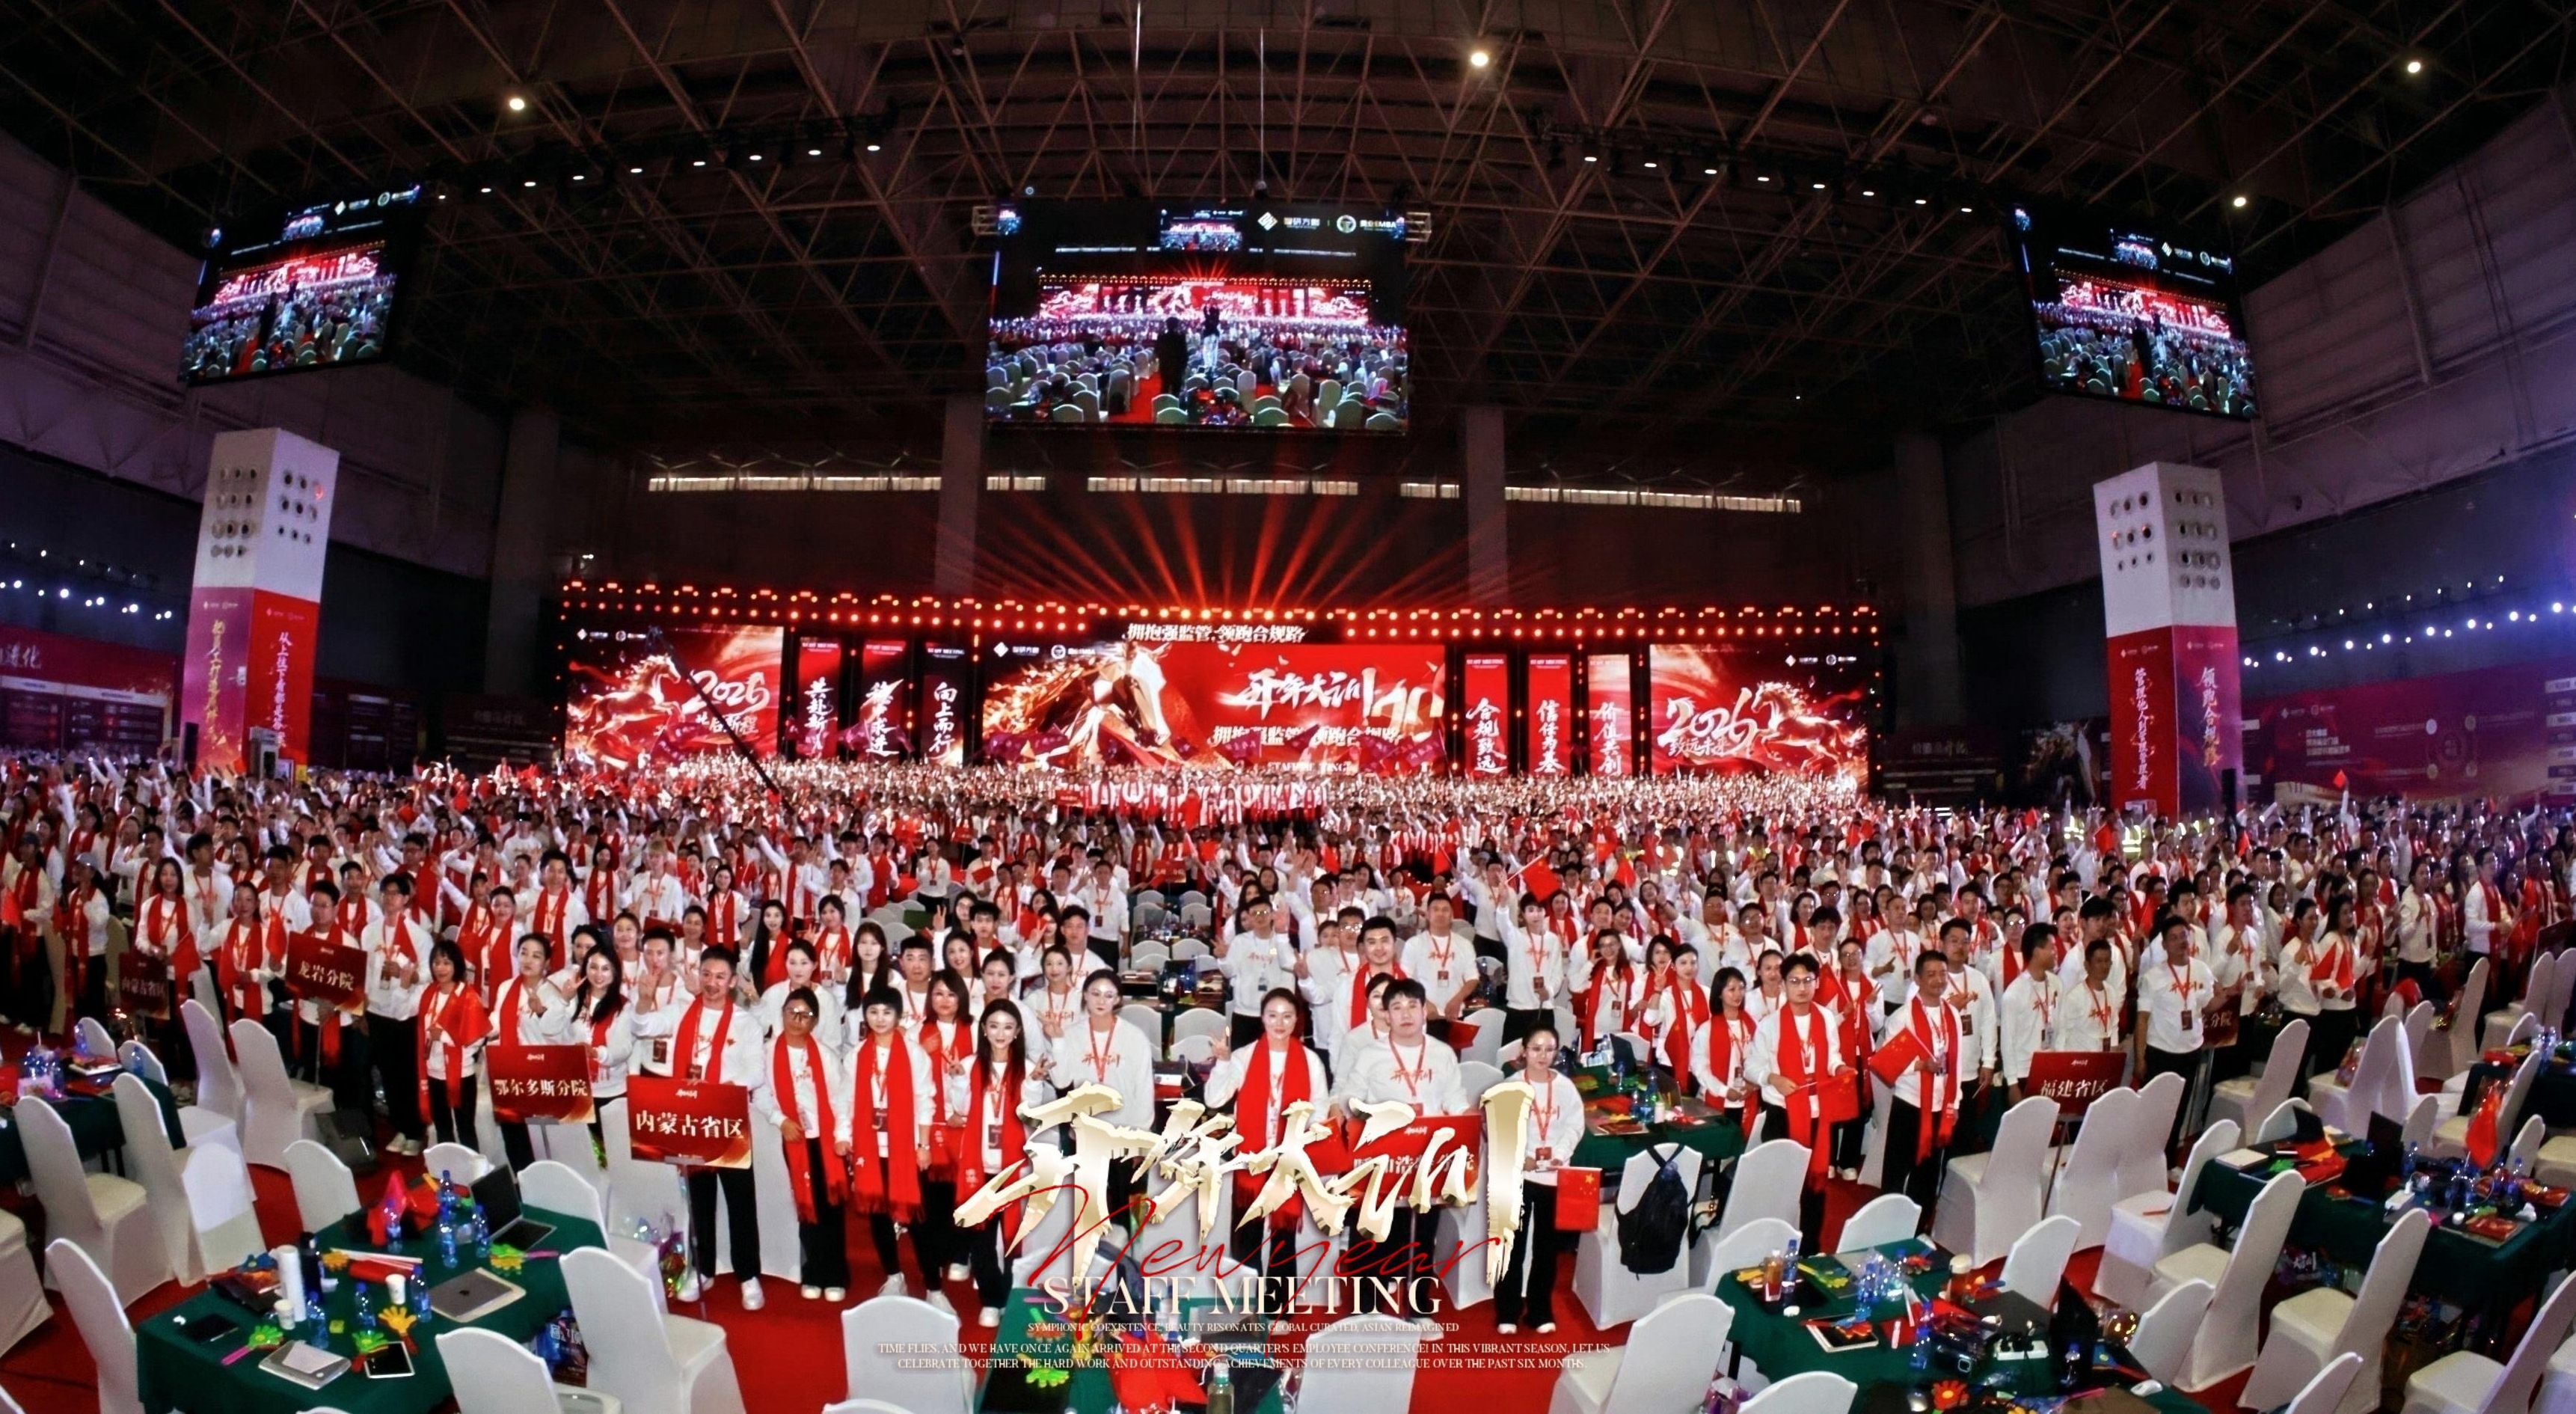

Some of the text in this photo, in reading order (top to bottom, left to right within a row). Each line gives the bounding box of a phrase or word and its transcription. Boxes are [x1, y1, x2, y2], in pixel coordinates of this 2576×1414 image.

[0, 642, 41, 668] 进化
[681, 670, 770, 715] 2026
[929, 682, 958, 759] 向上而行
[1465, 697, 1507, 774] 合规致远
[1535, 700, 1568, 773] 信任为基
[1593, 702, 1624, 775] 价值共创
[1657, 688, 1758, 758] 2026
[300, 961, 355, 991] 龙岩分院
[494, 1079, 589, 1097] 鄂尔多斯分院
[2040, 1079, 2109, 1098] 福建省区
[636, 1110, 744, 1139] 内蒙古省区
